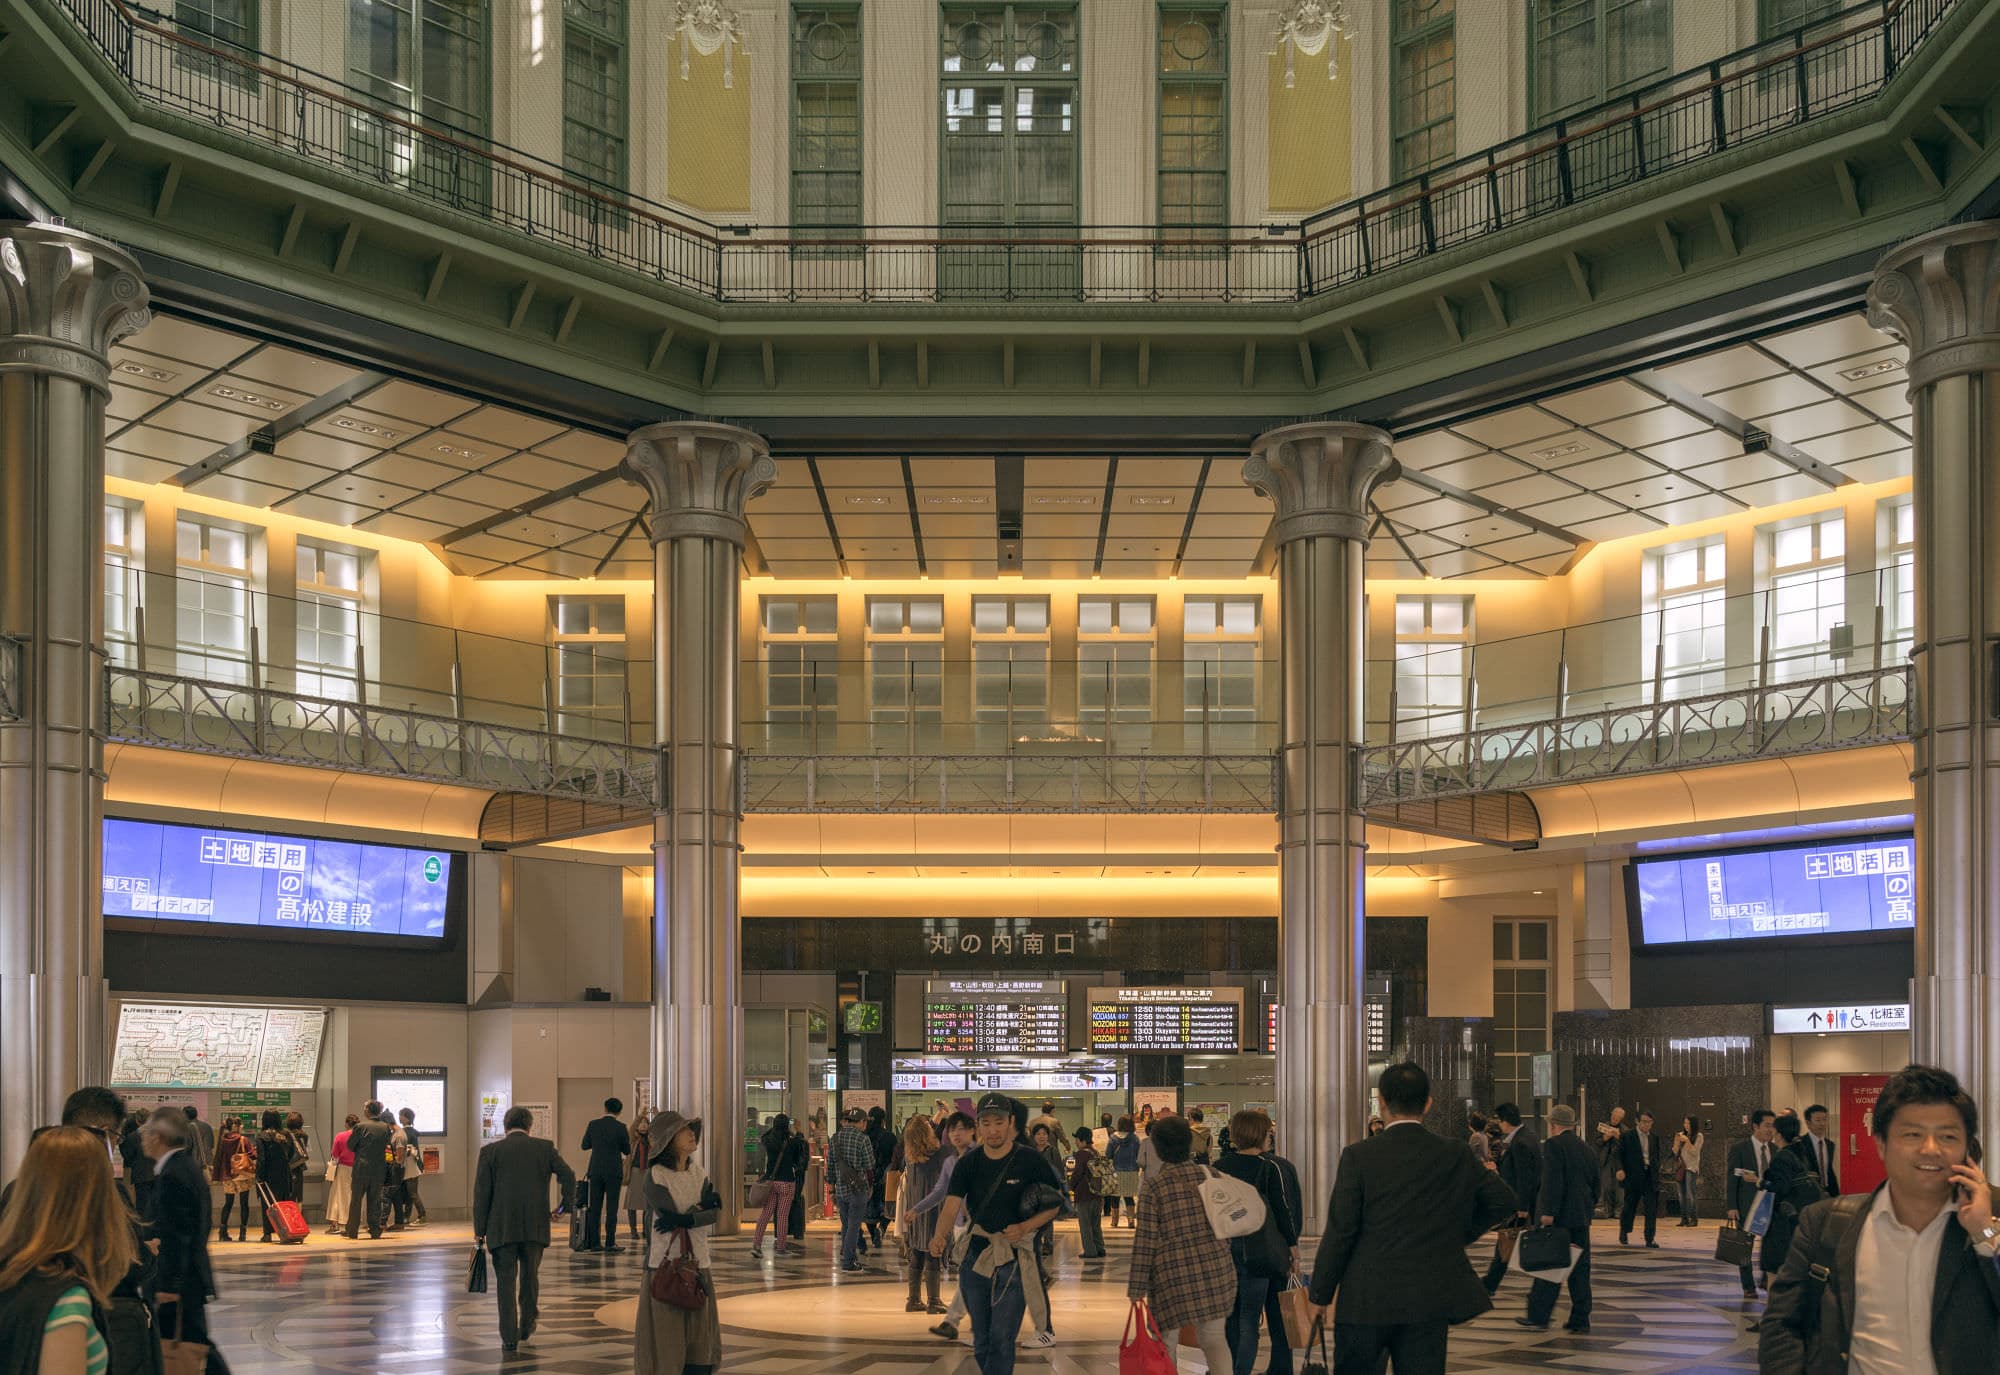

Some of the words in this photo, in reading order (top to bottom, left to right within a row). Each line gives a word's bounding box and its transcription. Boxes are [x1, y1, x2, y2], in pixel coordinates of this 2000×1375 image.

[204, 839, 304, 868] 土地活用
[1807, 848, 1909, 878] 土地活用
[281, 874, 302, 893] の
[930, 932, 1077, 955] 丸の内南口
[1869, 1006, 1906, 1020] 化粧室
[1869, 1020, 1907, 1028] Restrooms
[976, 1036, 995, 1044] 13:08
[976, 1044, 995, 1052] 13:12
